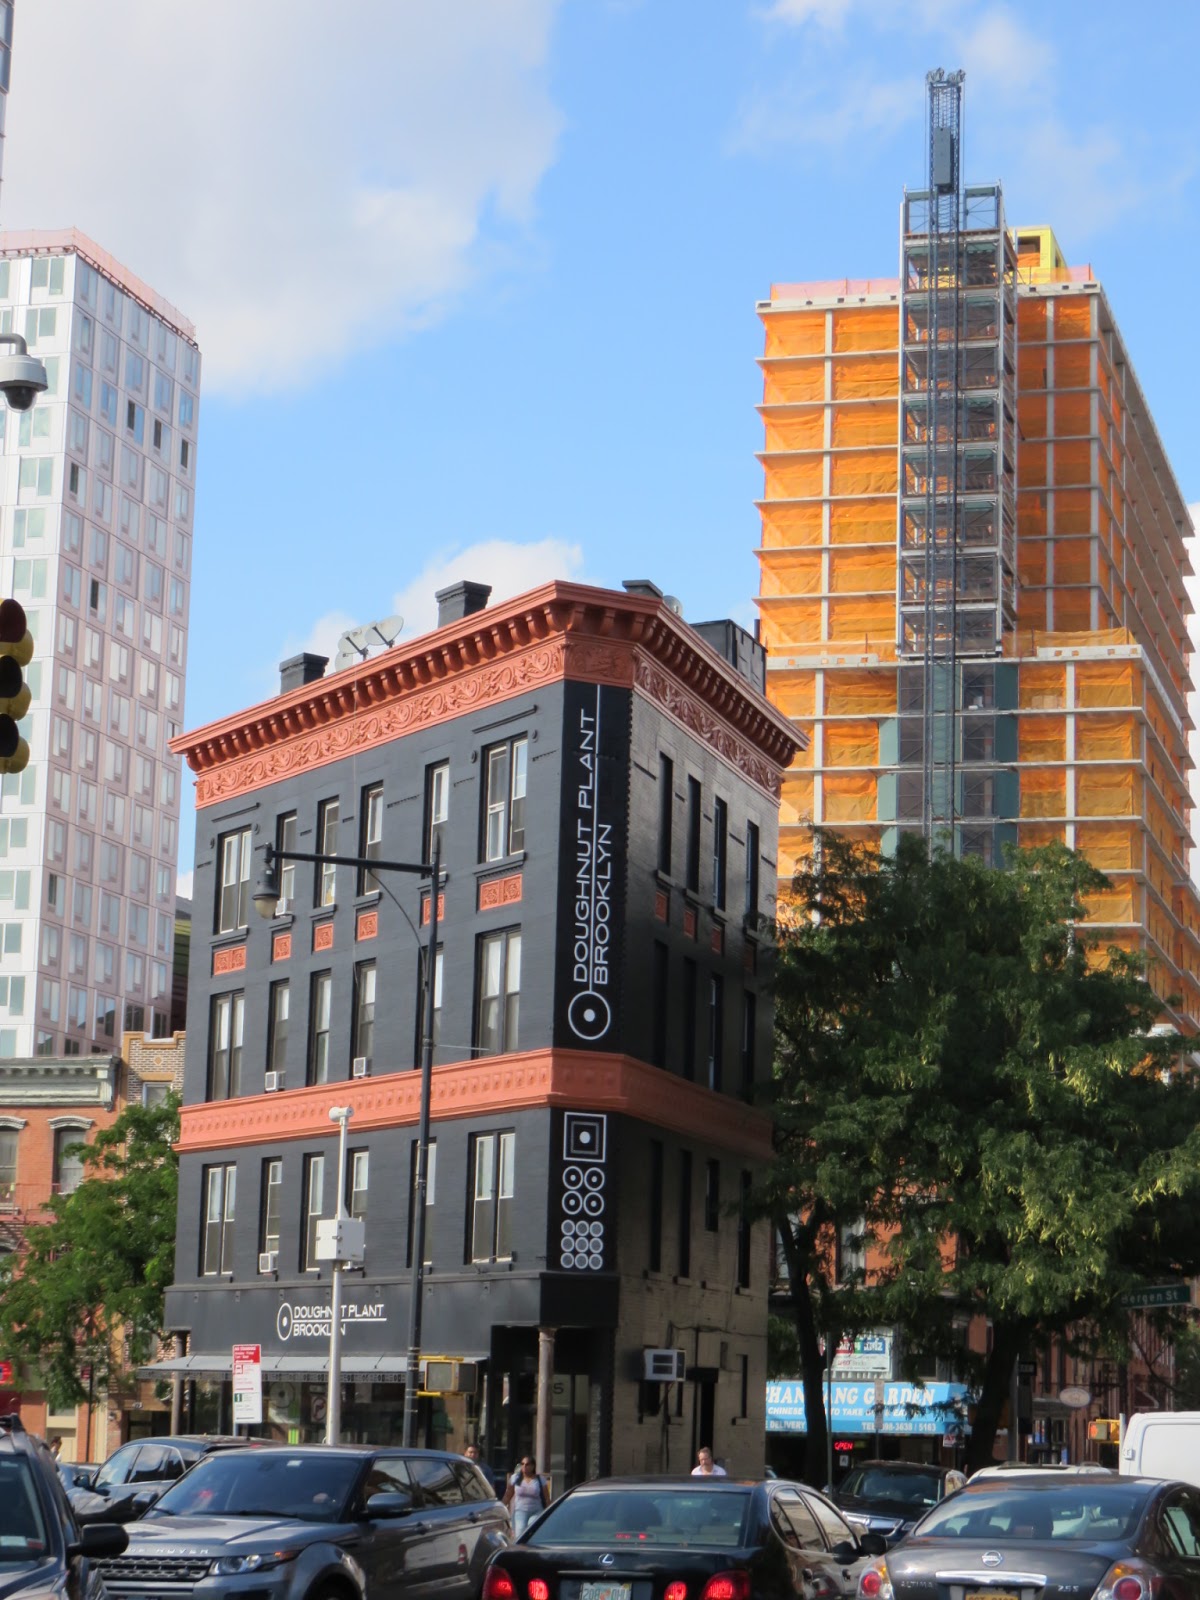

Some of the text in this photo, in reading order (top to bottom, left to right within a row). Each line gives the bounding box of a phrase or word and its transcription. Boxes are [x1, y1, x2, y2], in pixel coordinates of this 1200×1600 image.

[573, 708, 596, 983] DOUGHNUT PLANT
[593, 823, 612, 985] BROOKLYN
[1121, 1290, 1178, 1305] Bergen St
[294, 1304, 385, 1318] DOUGHNT PLANT
[293, 1323, 346, 1336] BROOKLN
[863, 1387, 935, 1405] GRDEN
[768, 1407, 803, 1415] CHINESE
[843, 1408, 863, 1416] TAKE
[770, 1420, 805, 1429] DELIVERY
[834, 1441, 853, 1451] OPEN
[900, 1580, 934, 1589] ALTIMA
